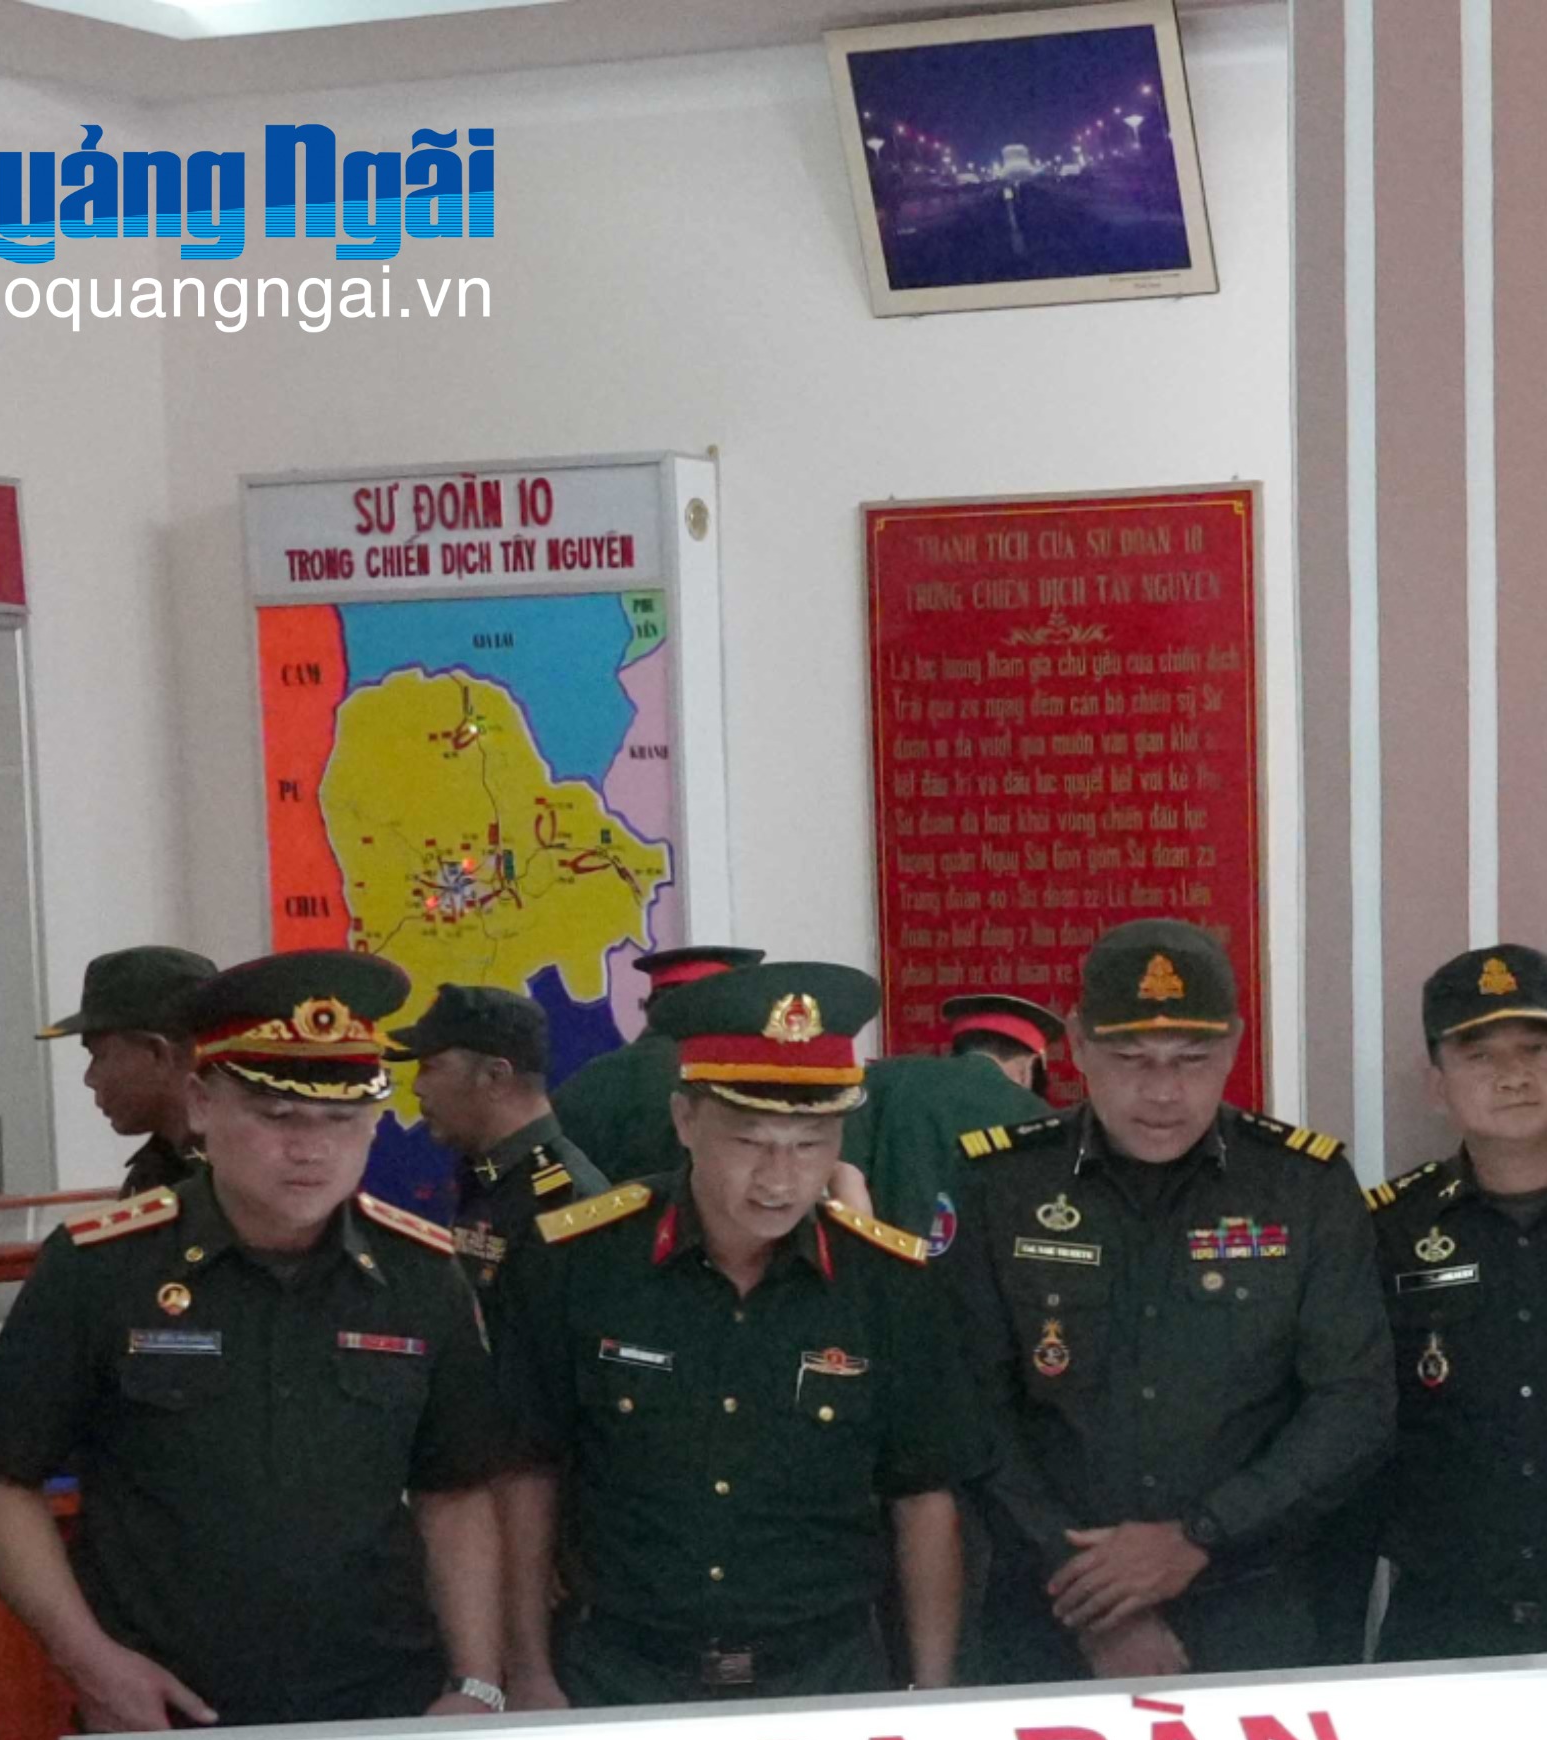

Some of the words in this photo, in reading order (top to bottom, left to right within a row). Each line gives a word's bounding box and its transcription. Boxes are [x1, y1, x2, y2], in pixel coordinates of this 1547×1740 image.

[516, 476, 554, 529] 10
[284, 547, 355, 583] TRONG
[499, 533, 538, 575] TÂY
[542, 530, 636, 574] NGUYÊN
